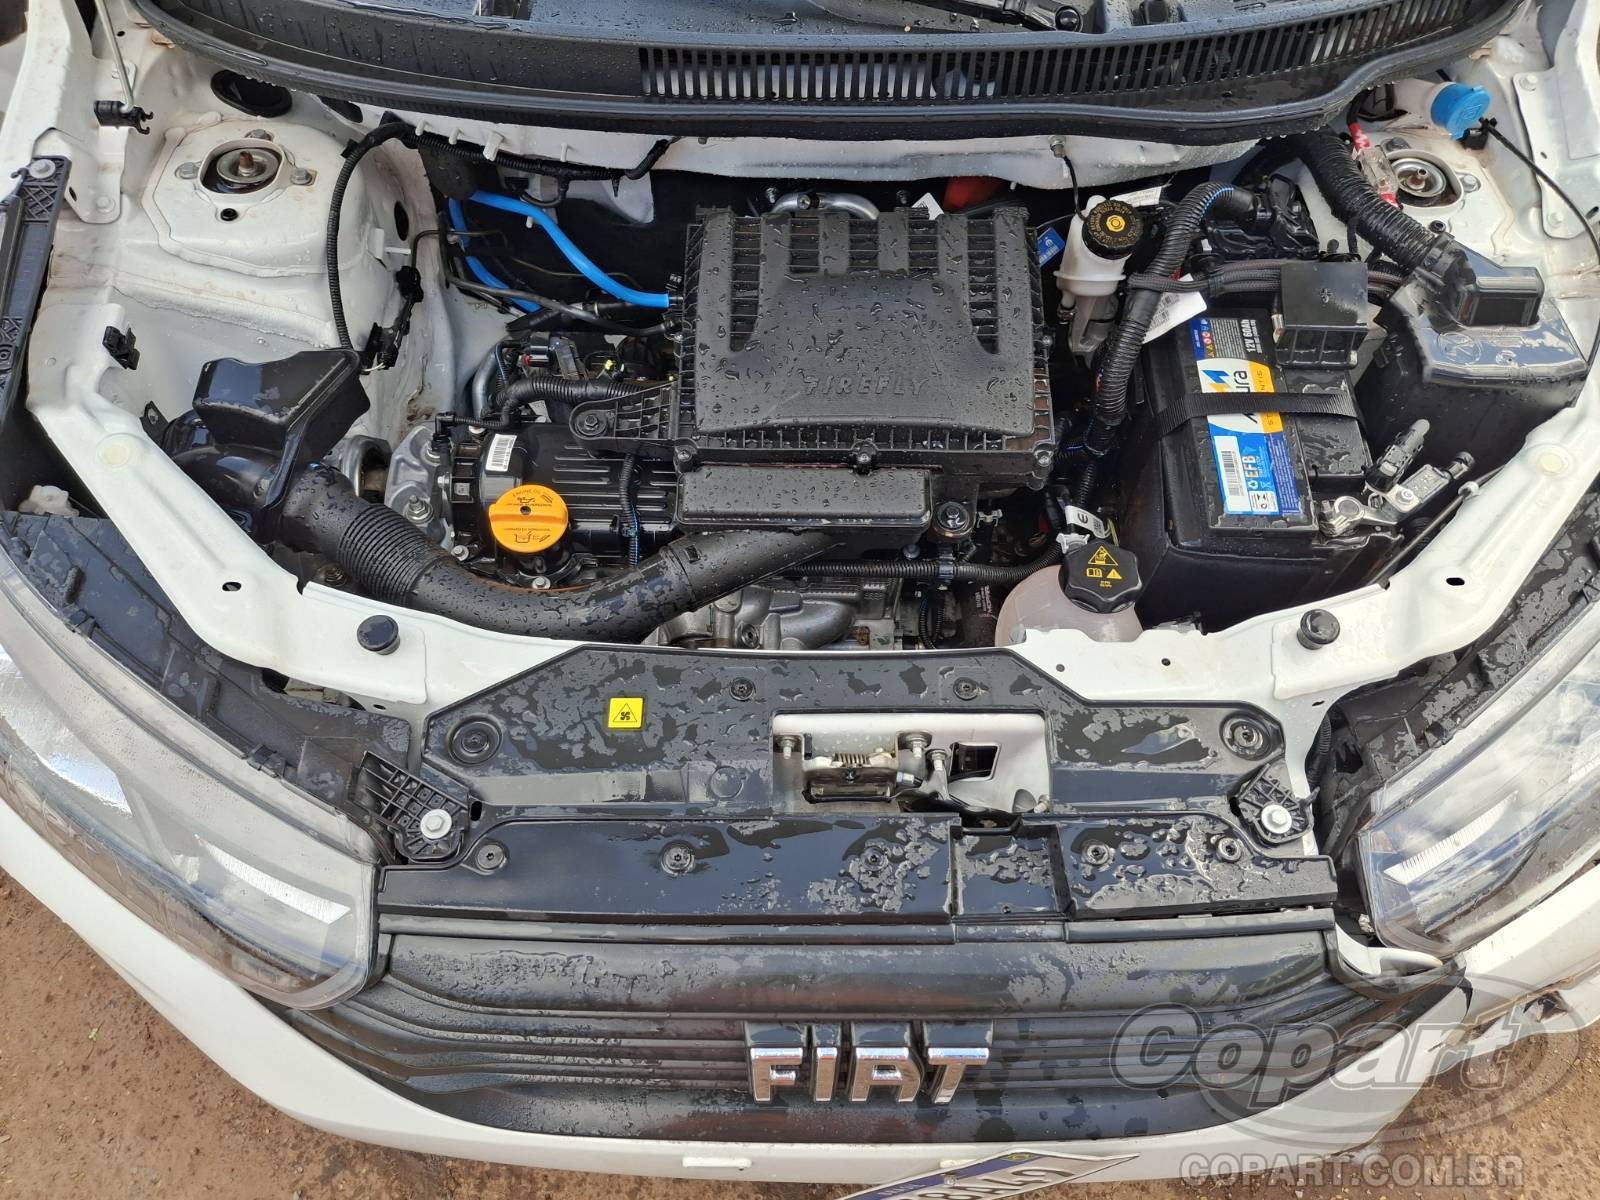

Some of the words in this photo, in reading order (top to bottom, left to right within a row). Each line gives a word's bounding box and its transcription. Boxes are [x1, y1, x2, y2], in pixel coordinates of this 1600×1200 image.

[1240, 319, 1253, 337] 60Ah
[1244, 338, 1257, 353] 12V
[803, 375, 930, 396] FIREFLY
[1242, 455, 1260, 478] EFB
[746, 1028, 992, 1104] FIAT
